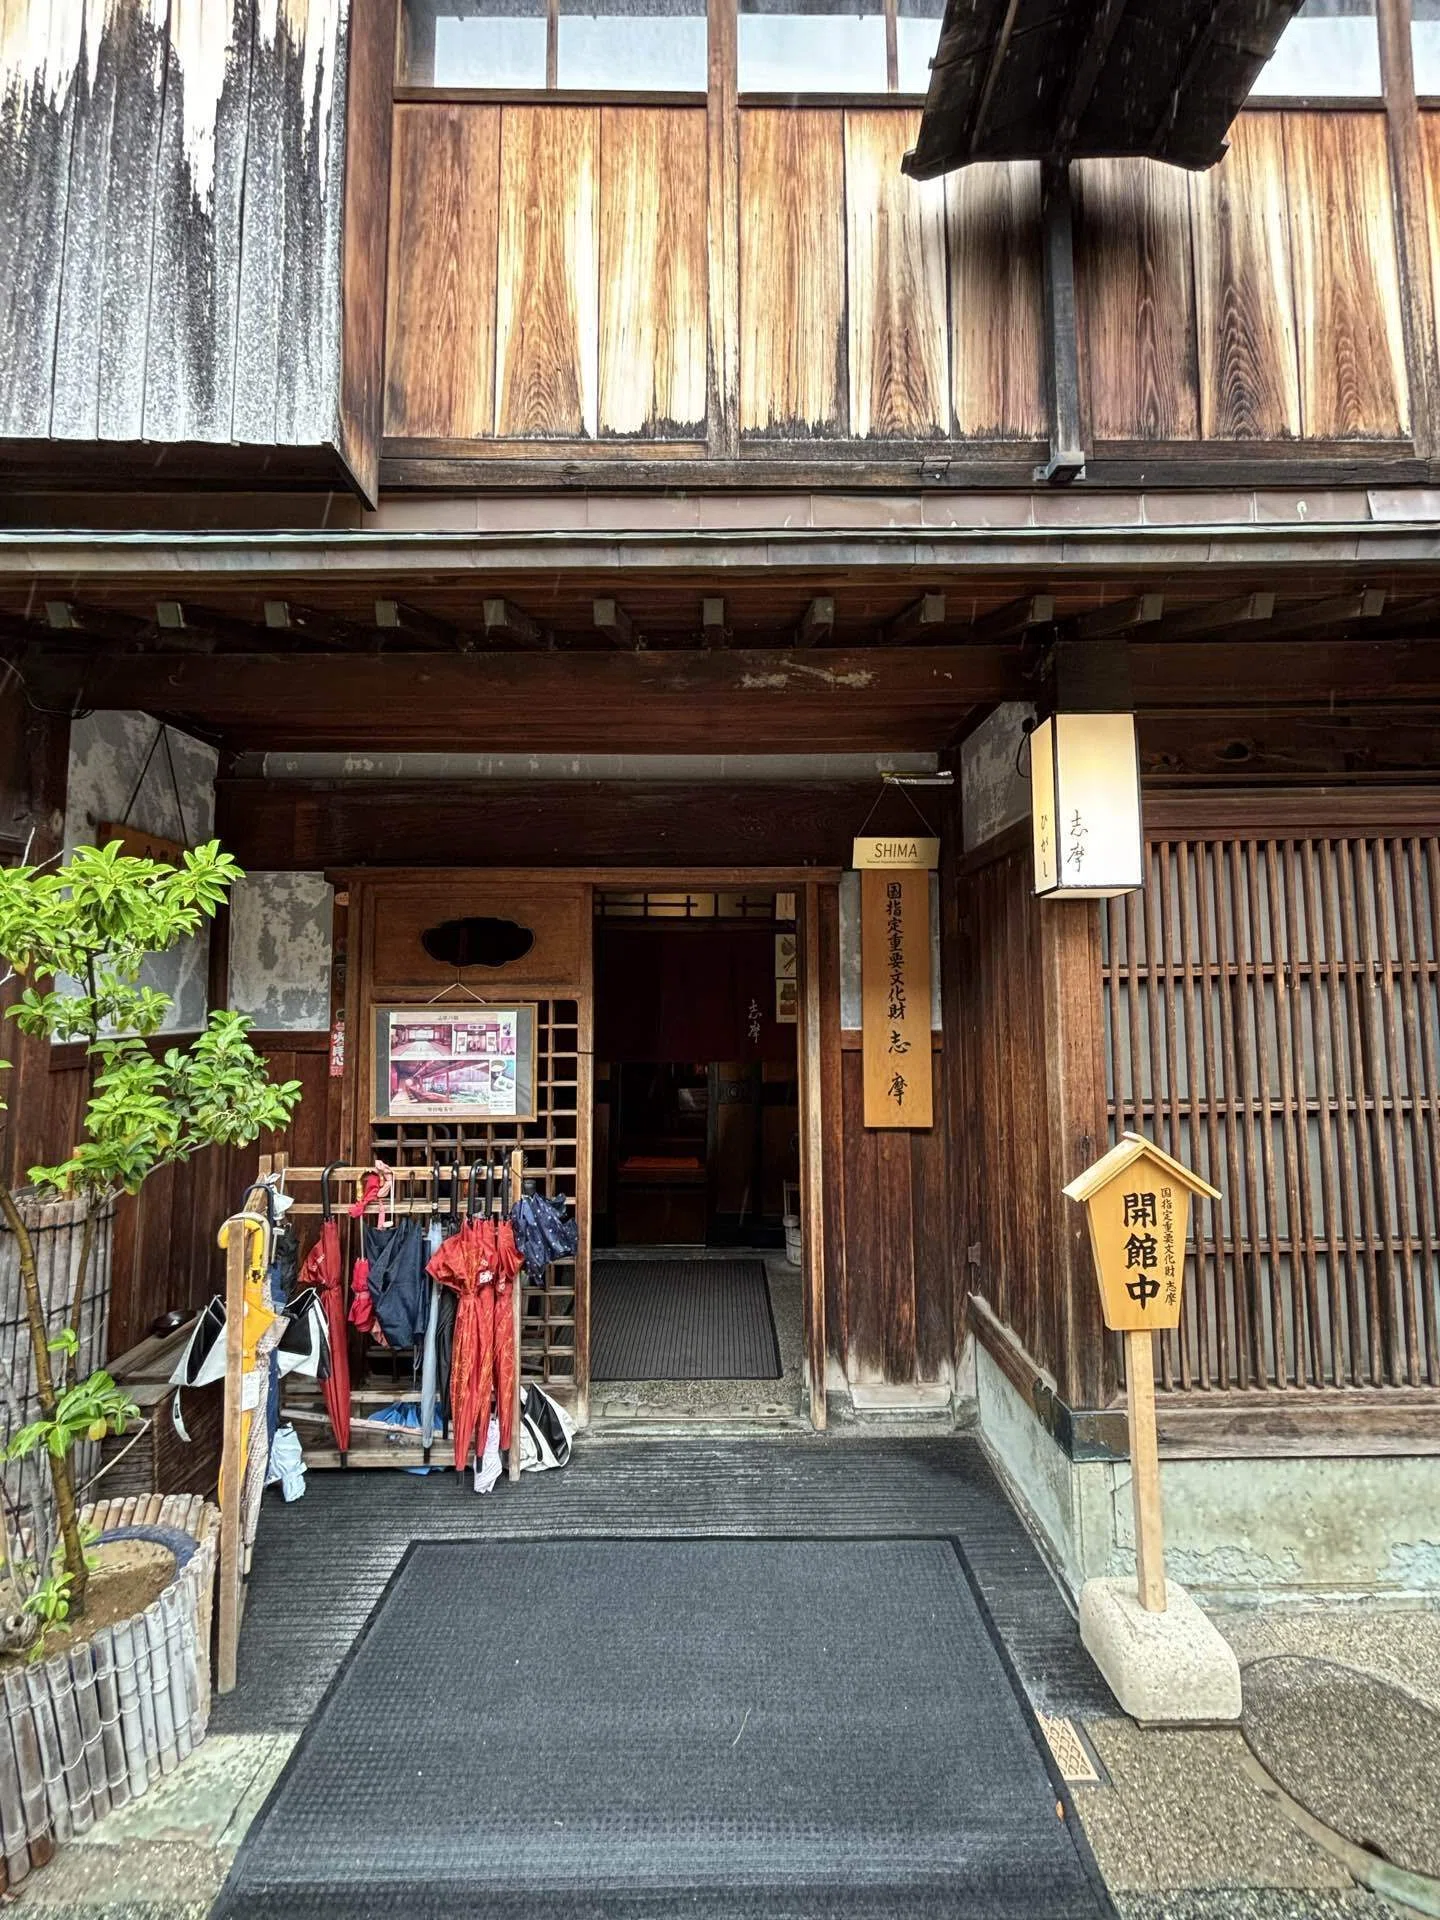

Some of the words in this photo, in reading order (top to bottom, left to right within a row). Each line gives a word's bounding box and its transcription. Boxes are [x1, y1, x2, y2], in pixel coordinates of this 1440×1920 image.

[874, 842, 918, 858] SHIMA
[1067, 809, 1088, 872] 志摩
[886, 882, 906, 1020] 国指定重要文化財
[748, 998, 762, 1043] 志摩
[888, 1030, 911, 1106] 志摩
[1122, 1192, 1161, 1311] 開館中
[1160, 1187, 1176, 1278] 国指定重要文化財
[1164, 1280, 1177, 1306] 志摩
